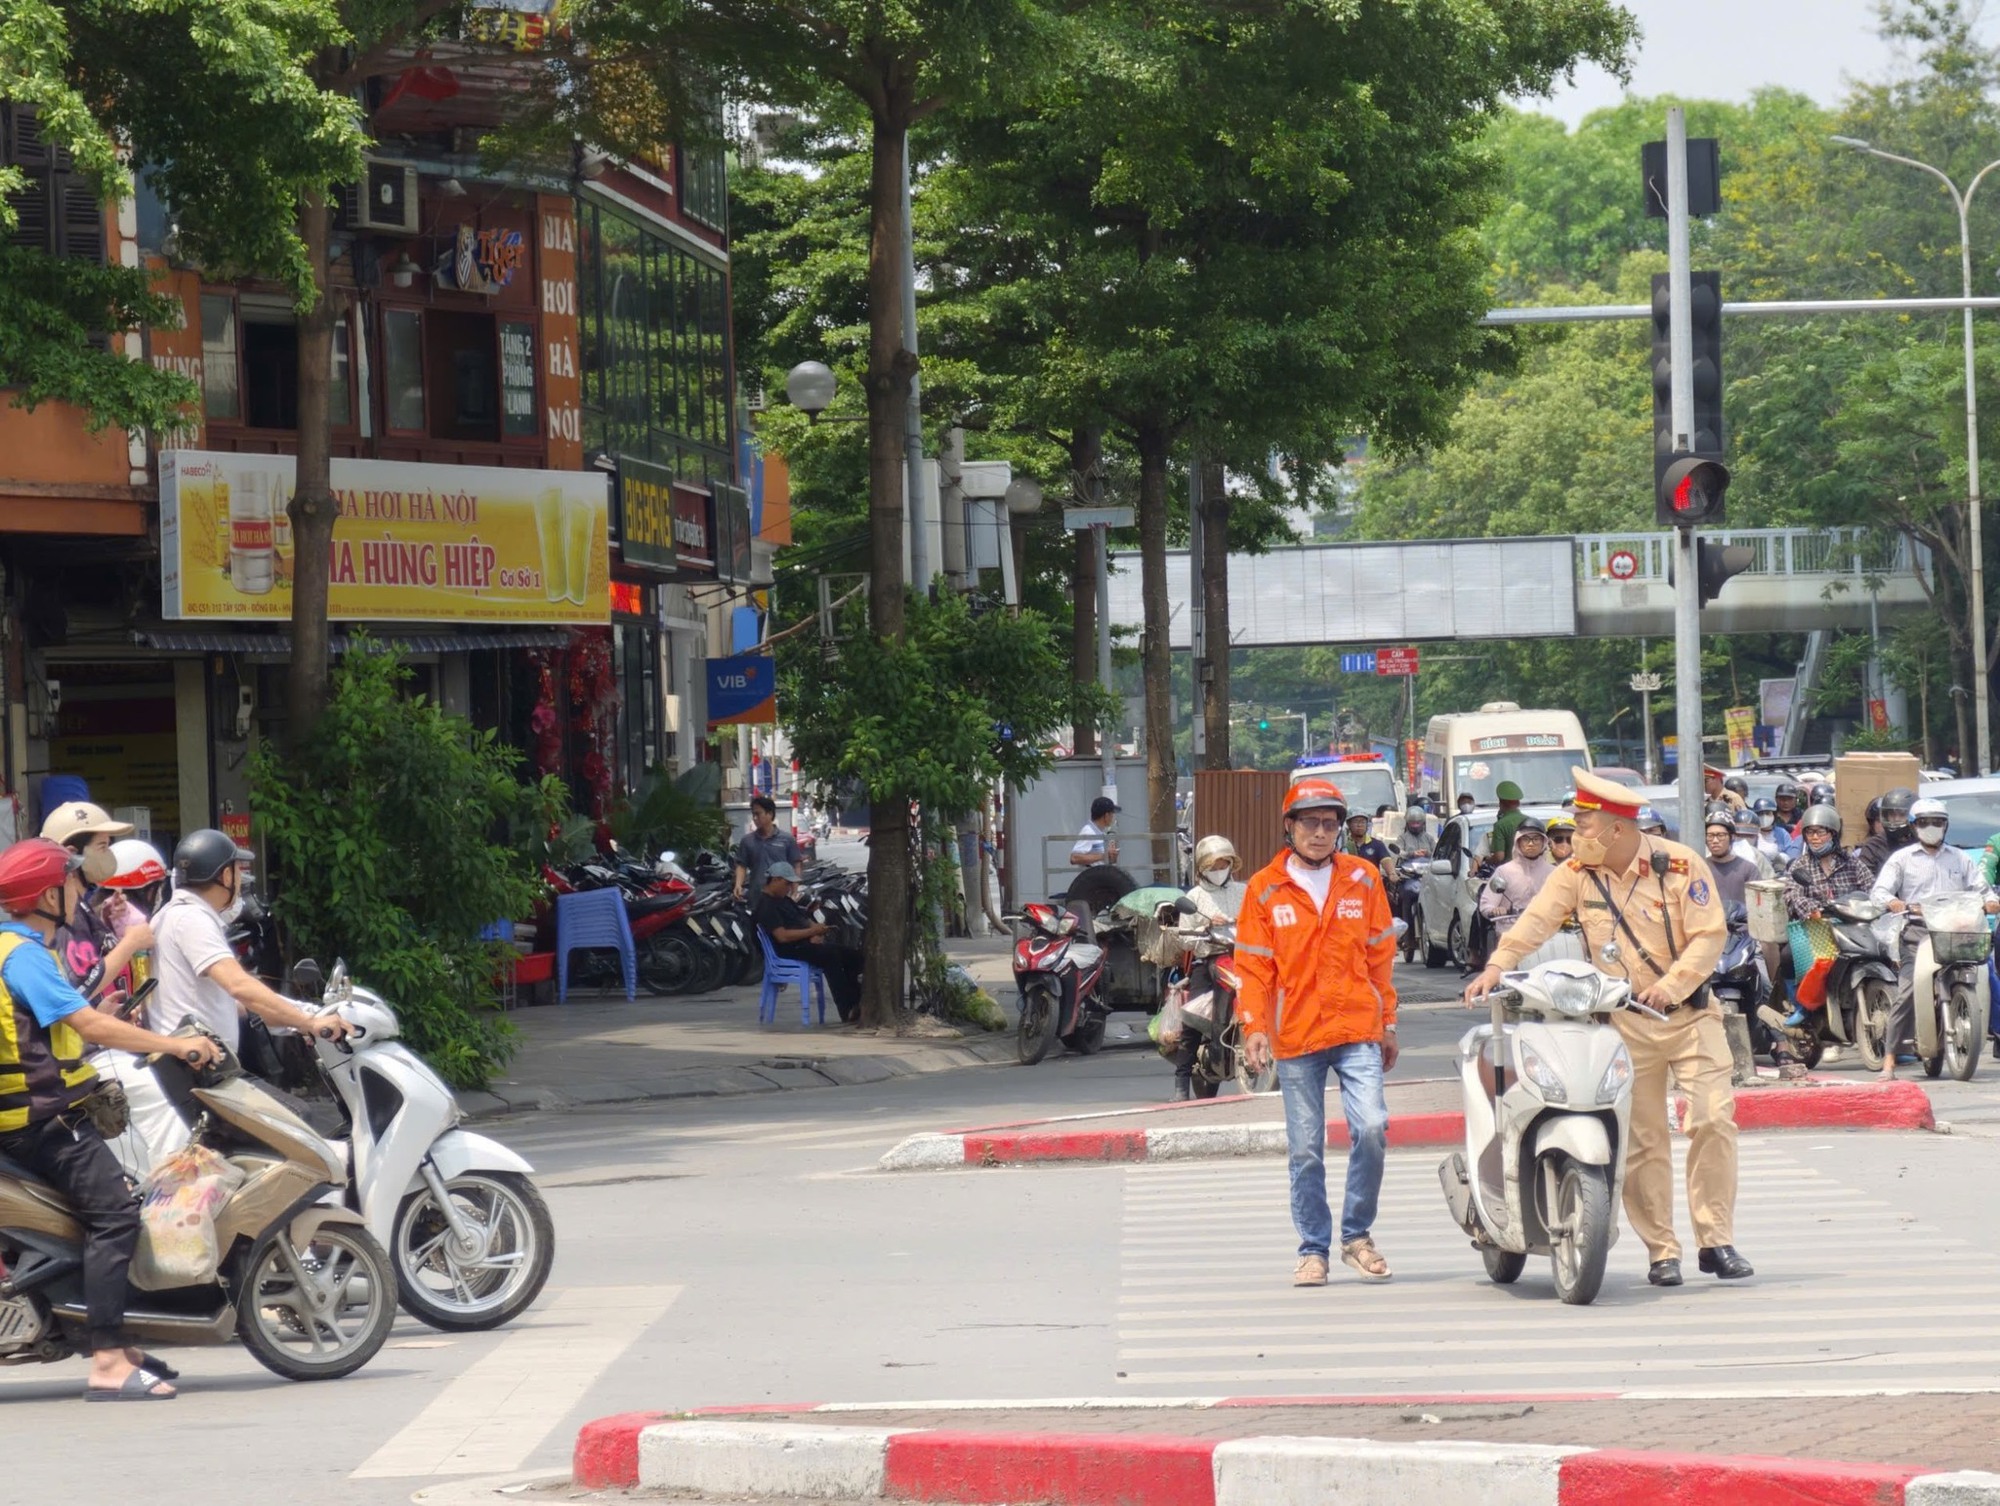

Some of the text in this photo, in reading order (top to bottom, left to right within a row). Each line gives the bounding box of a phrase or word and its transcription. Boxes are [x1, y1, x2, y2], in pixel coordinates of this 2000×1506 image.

[544, 215, 574, 253] BIA
[543, 278, 574, 315] HƠI
[525, 335, 532, 356] 2
[549, 335, 575, 379] HÀ
[548, 400, 580, 448] NỘI
[181, 465, 206, 477] HABECO
[328, 488, 359, 518] IA
[408, 486, 437, 520] HÀ
[441, 488, 478, 531] NỘI
[362, 532, 438, 586] HÙNG
[443, 535, 496, 596] HIỆP
[534, 573, 540, 588] 1
[717, 675, 747, 688] VIB
